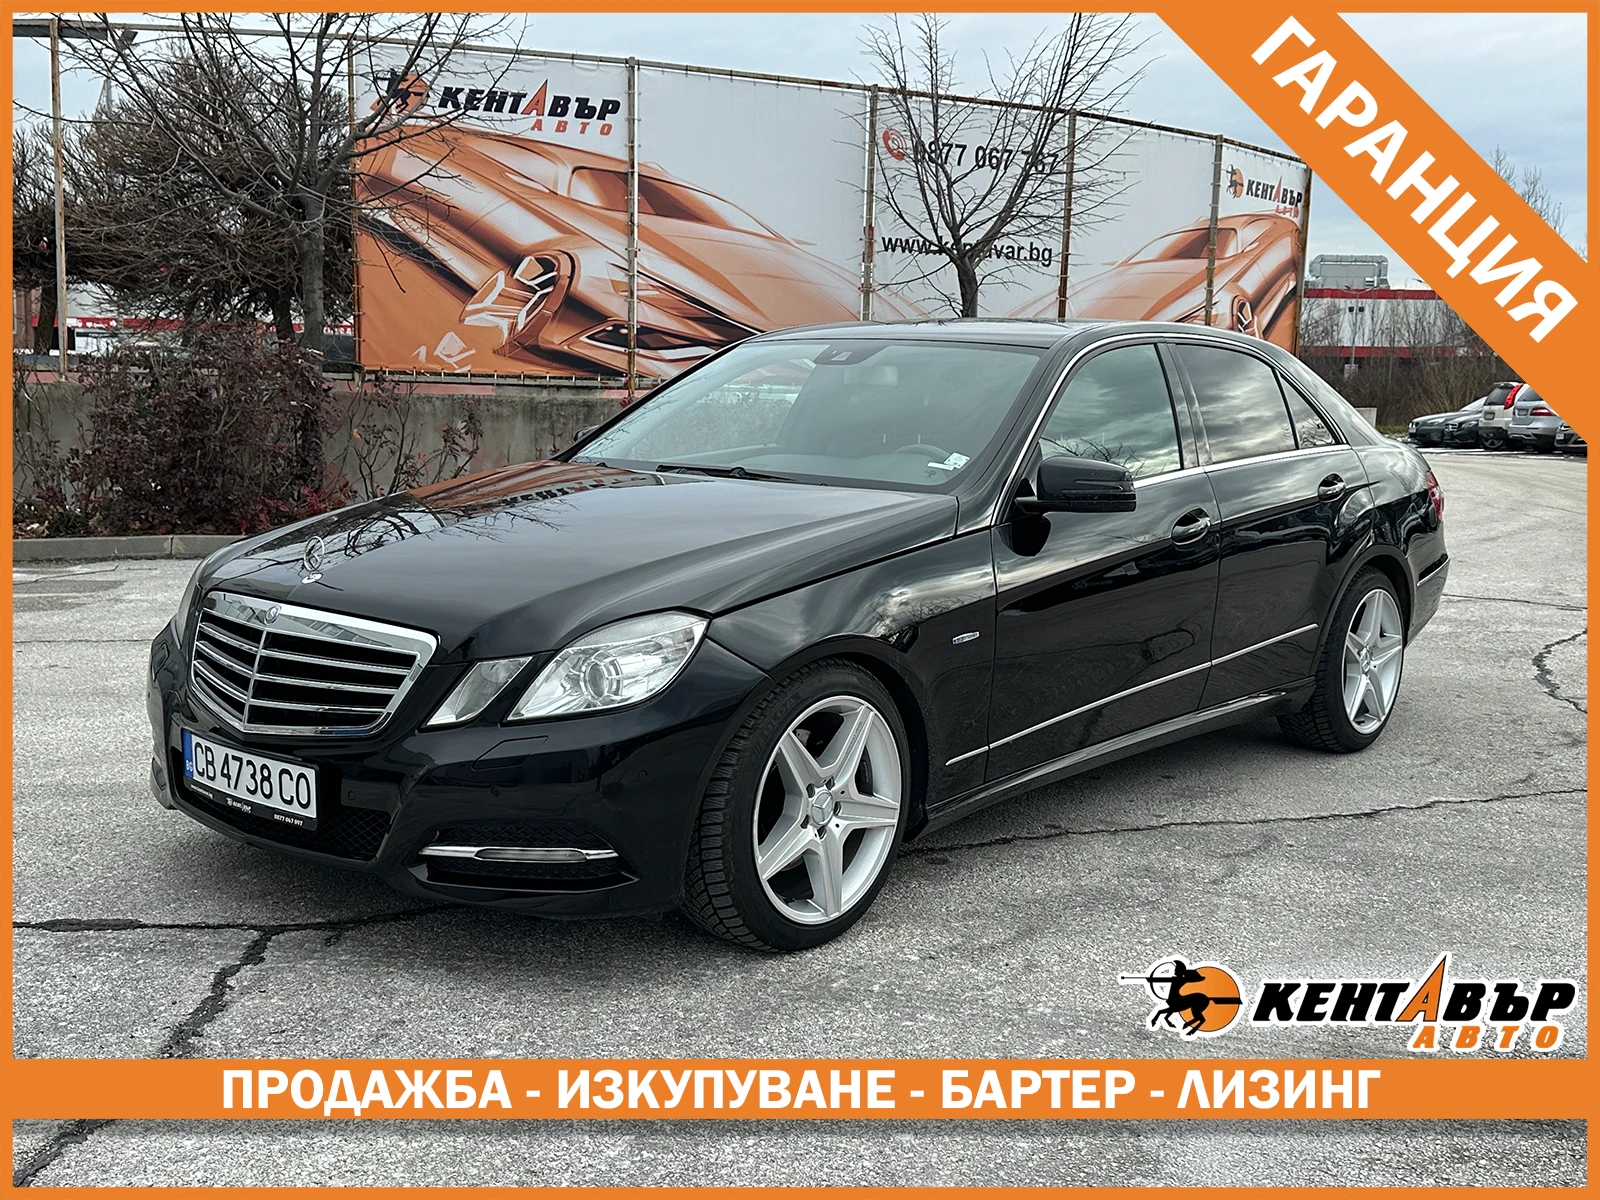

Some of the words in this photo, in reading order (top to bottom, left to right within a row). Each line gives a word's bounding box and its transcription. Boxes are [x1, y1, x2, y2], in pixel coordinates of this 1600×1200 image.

[437, 79, 622, 121] КЕНТАВЪР
[530, 118, 613, 136] АВТО
[974, 145, 1013, 170] 067
[1245, 175, 1303, 208] КЕНТАВЪР
[194, 741, 216, 782] CB
[220, 752, 274, 800] 4738
